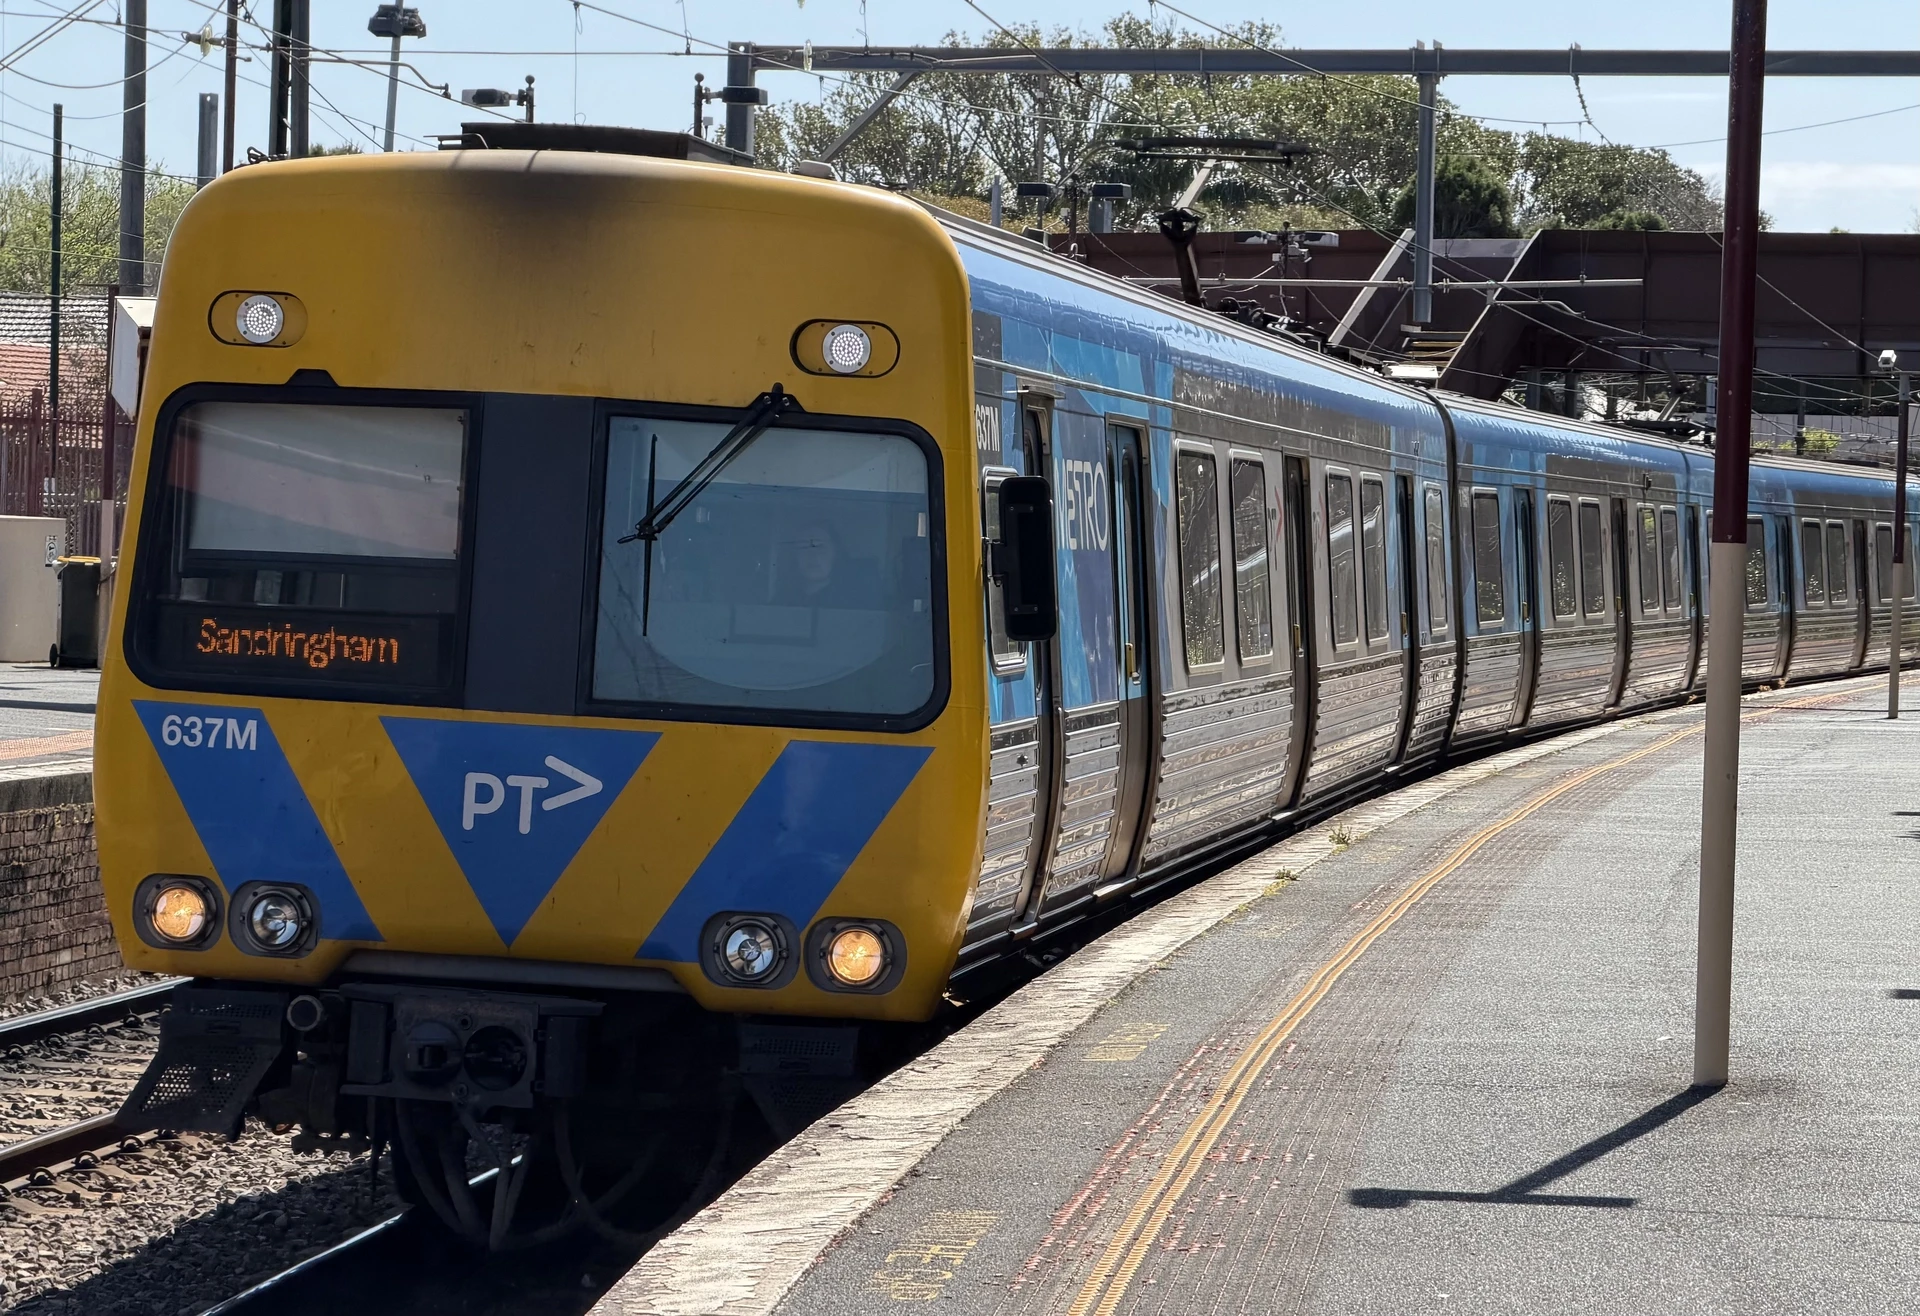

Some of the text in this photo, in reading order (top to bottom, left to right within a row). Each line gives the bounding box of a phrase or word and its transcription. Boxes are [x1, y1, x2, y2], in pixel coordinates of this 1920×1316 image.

[976, 403, 1000, 452] 637M
[1054, 457, 1108, 551] METRO
[196, 618, 400, 669] Sandringham
[161, 713, 258, 751] 637M
[884, 1238, 980, 1265] THE
[862, 1268, 953, 1300] GAP
